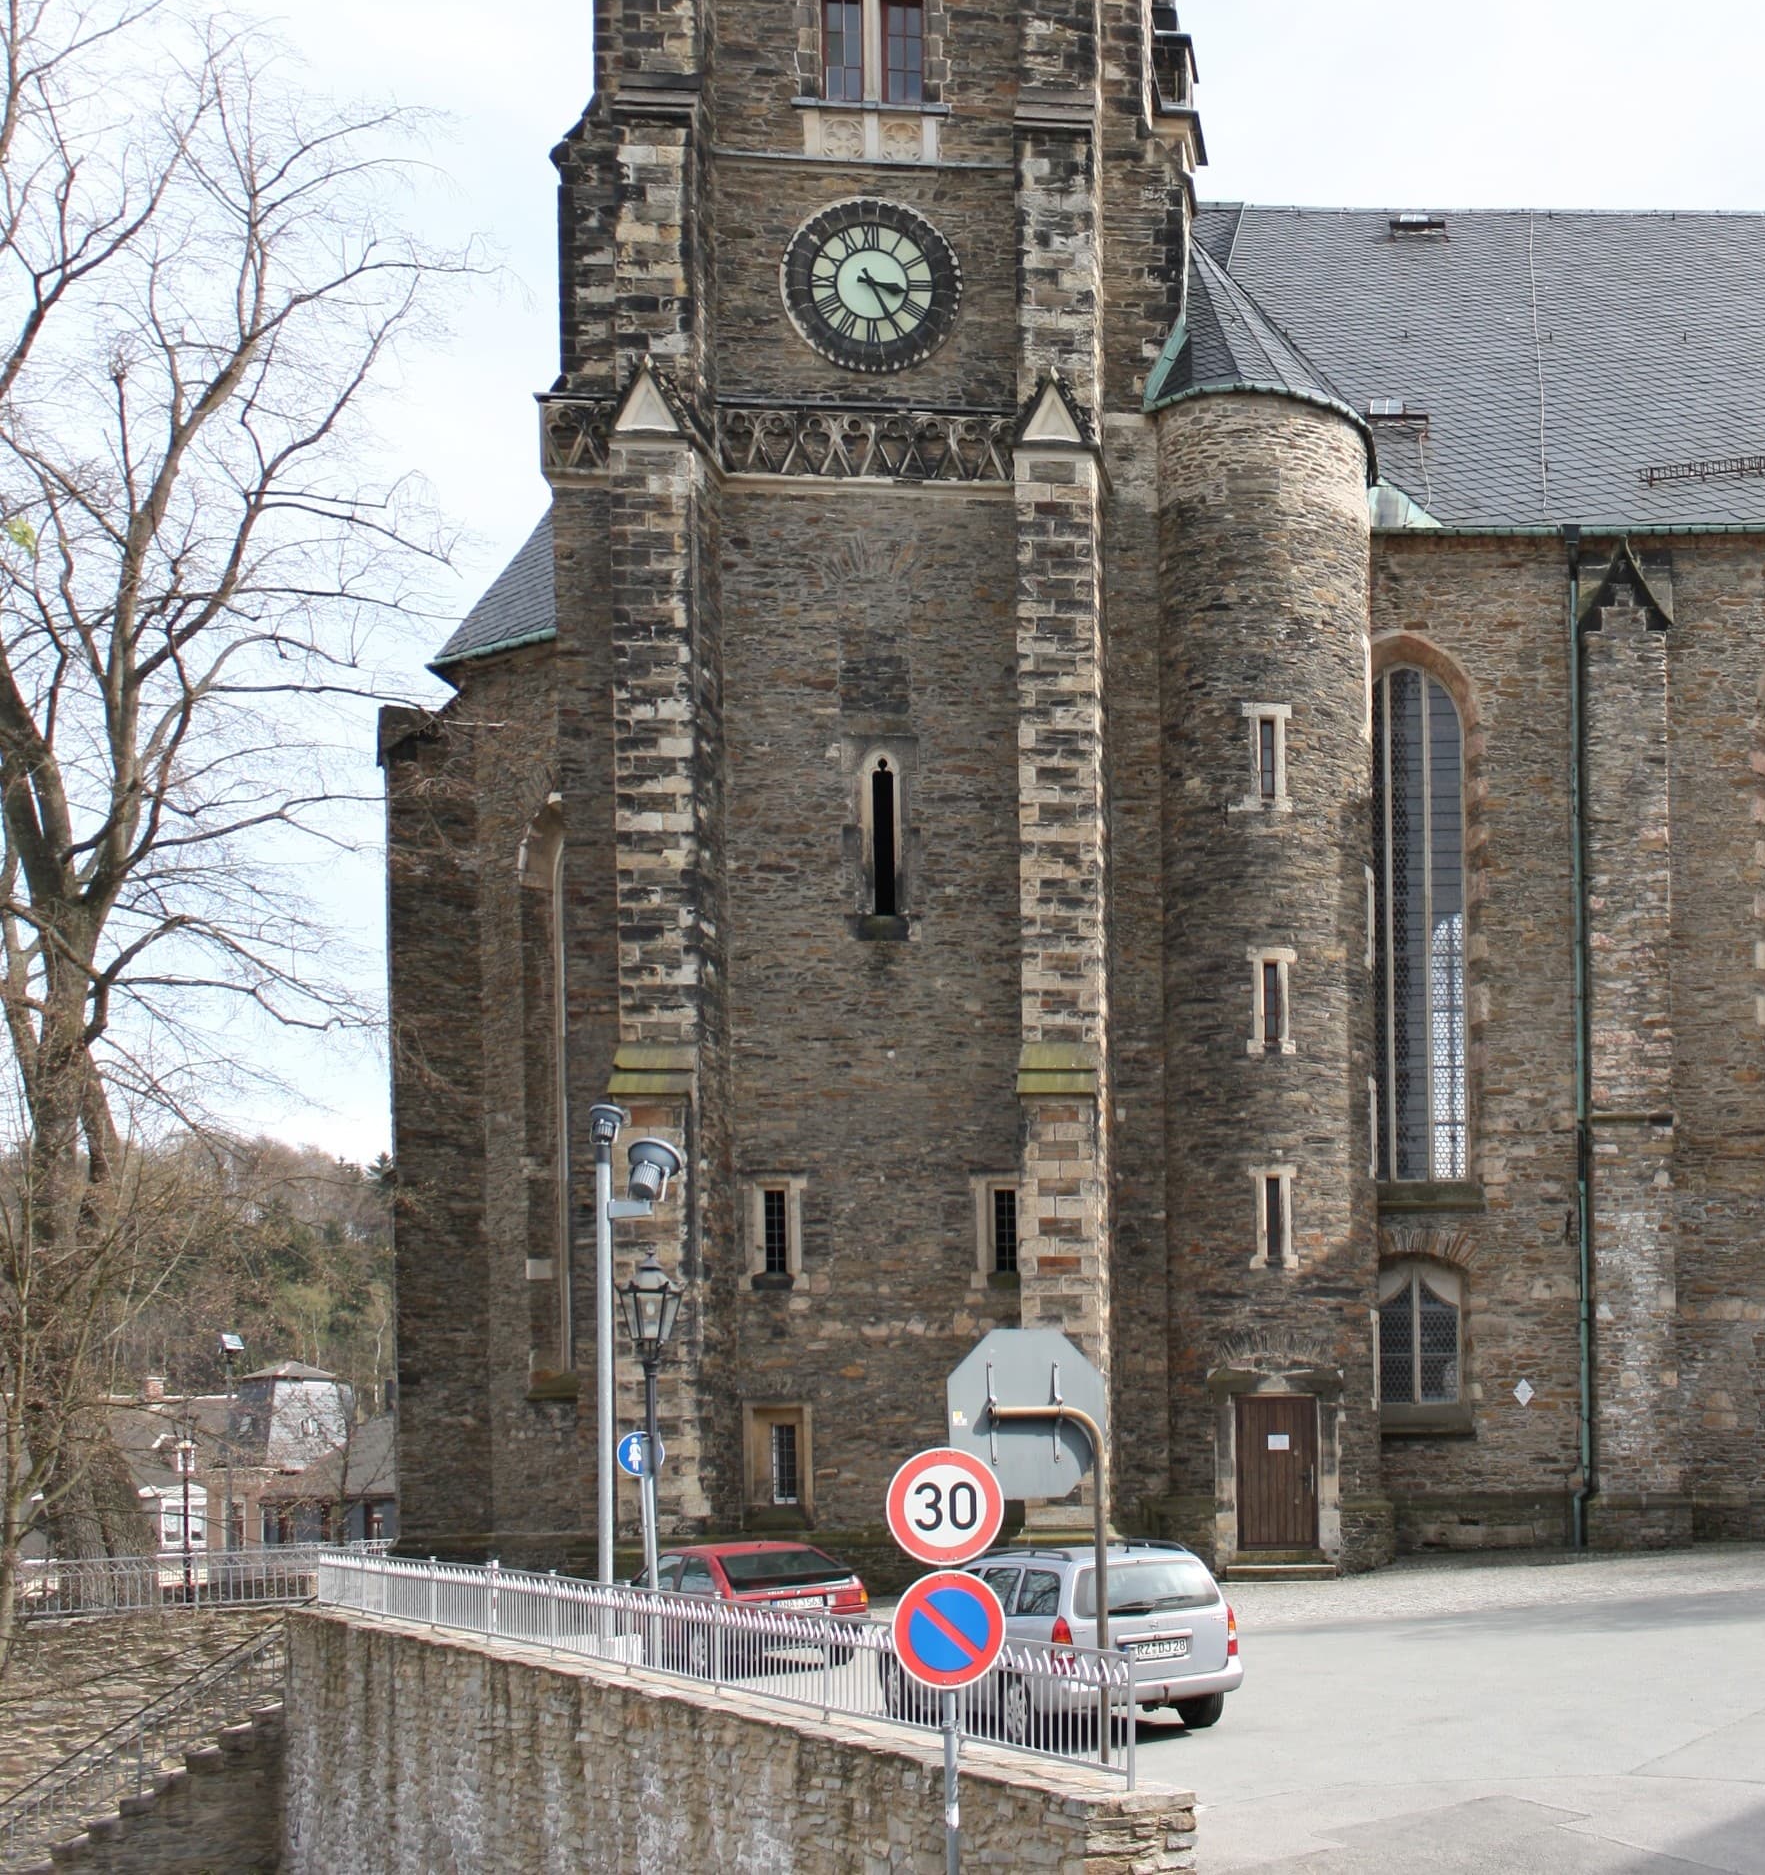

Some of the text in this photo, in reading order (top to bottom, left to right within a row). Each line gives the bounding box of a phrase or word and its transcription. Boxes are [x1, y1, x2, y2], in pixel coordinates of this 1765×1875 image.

[836, 228, 859, 255] XI
[861, 225, 880, 249] XII
[816, 247, 841, 269] X
[903, 254, 926, 270] II
[810, 273, 837, 288] IX
[908, 279, 933, 292] III
[815, 292, 842, 321] VIII
[836, 309, 857, 339] VII
[866, 319, 881, 342] VI
[914, 1481, 977, 1531] 30
